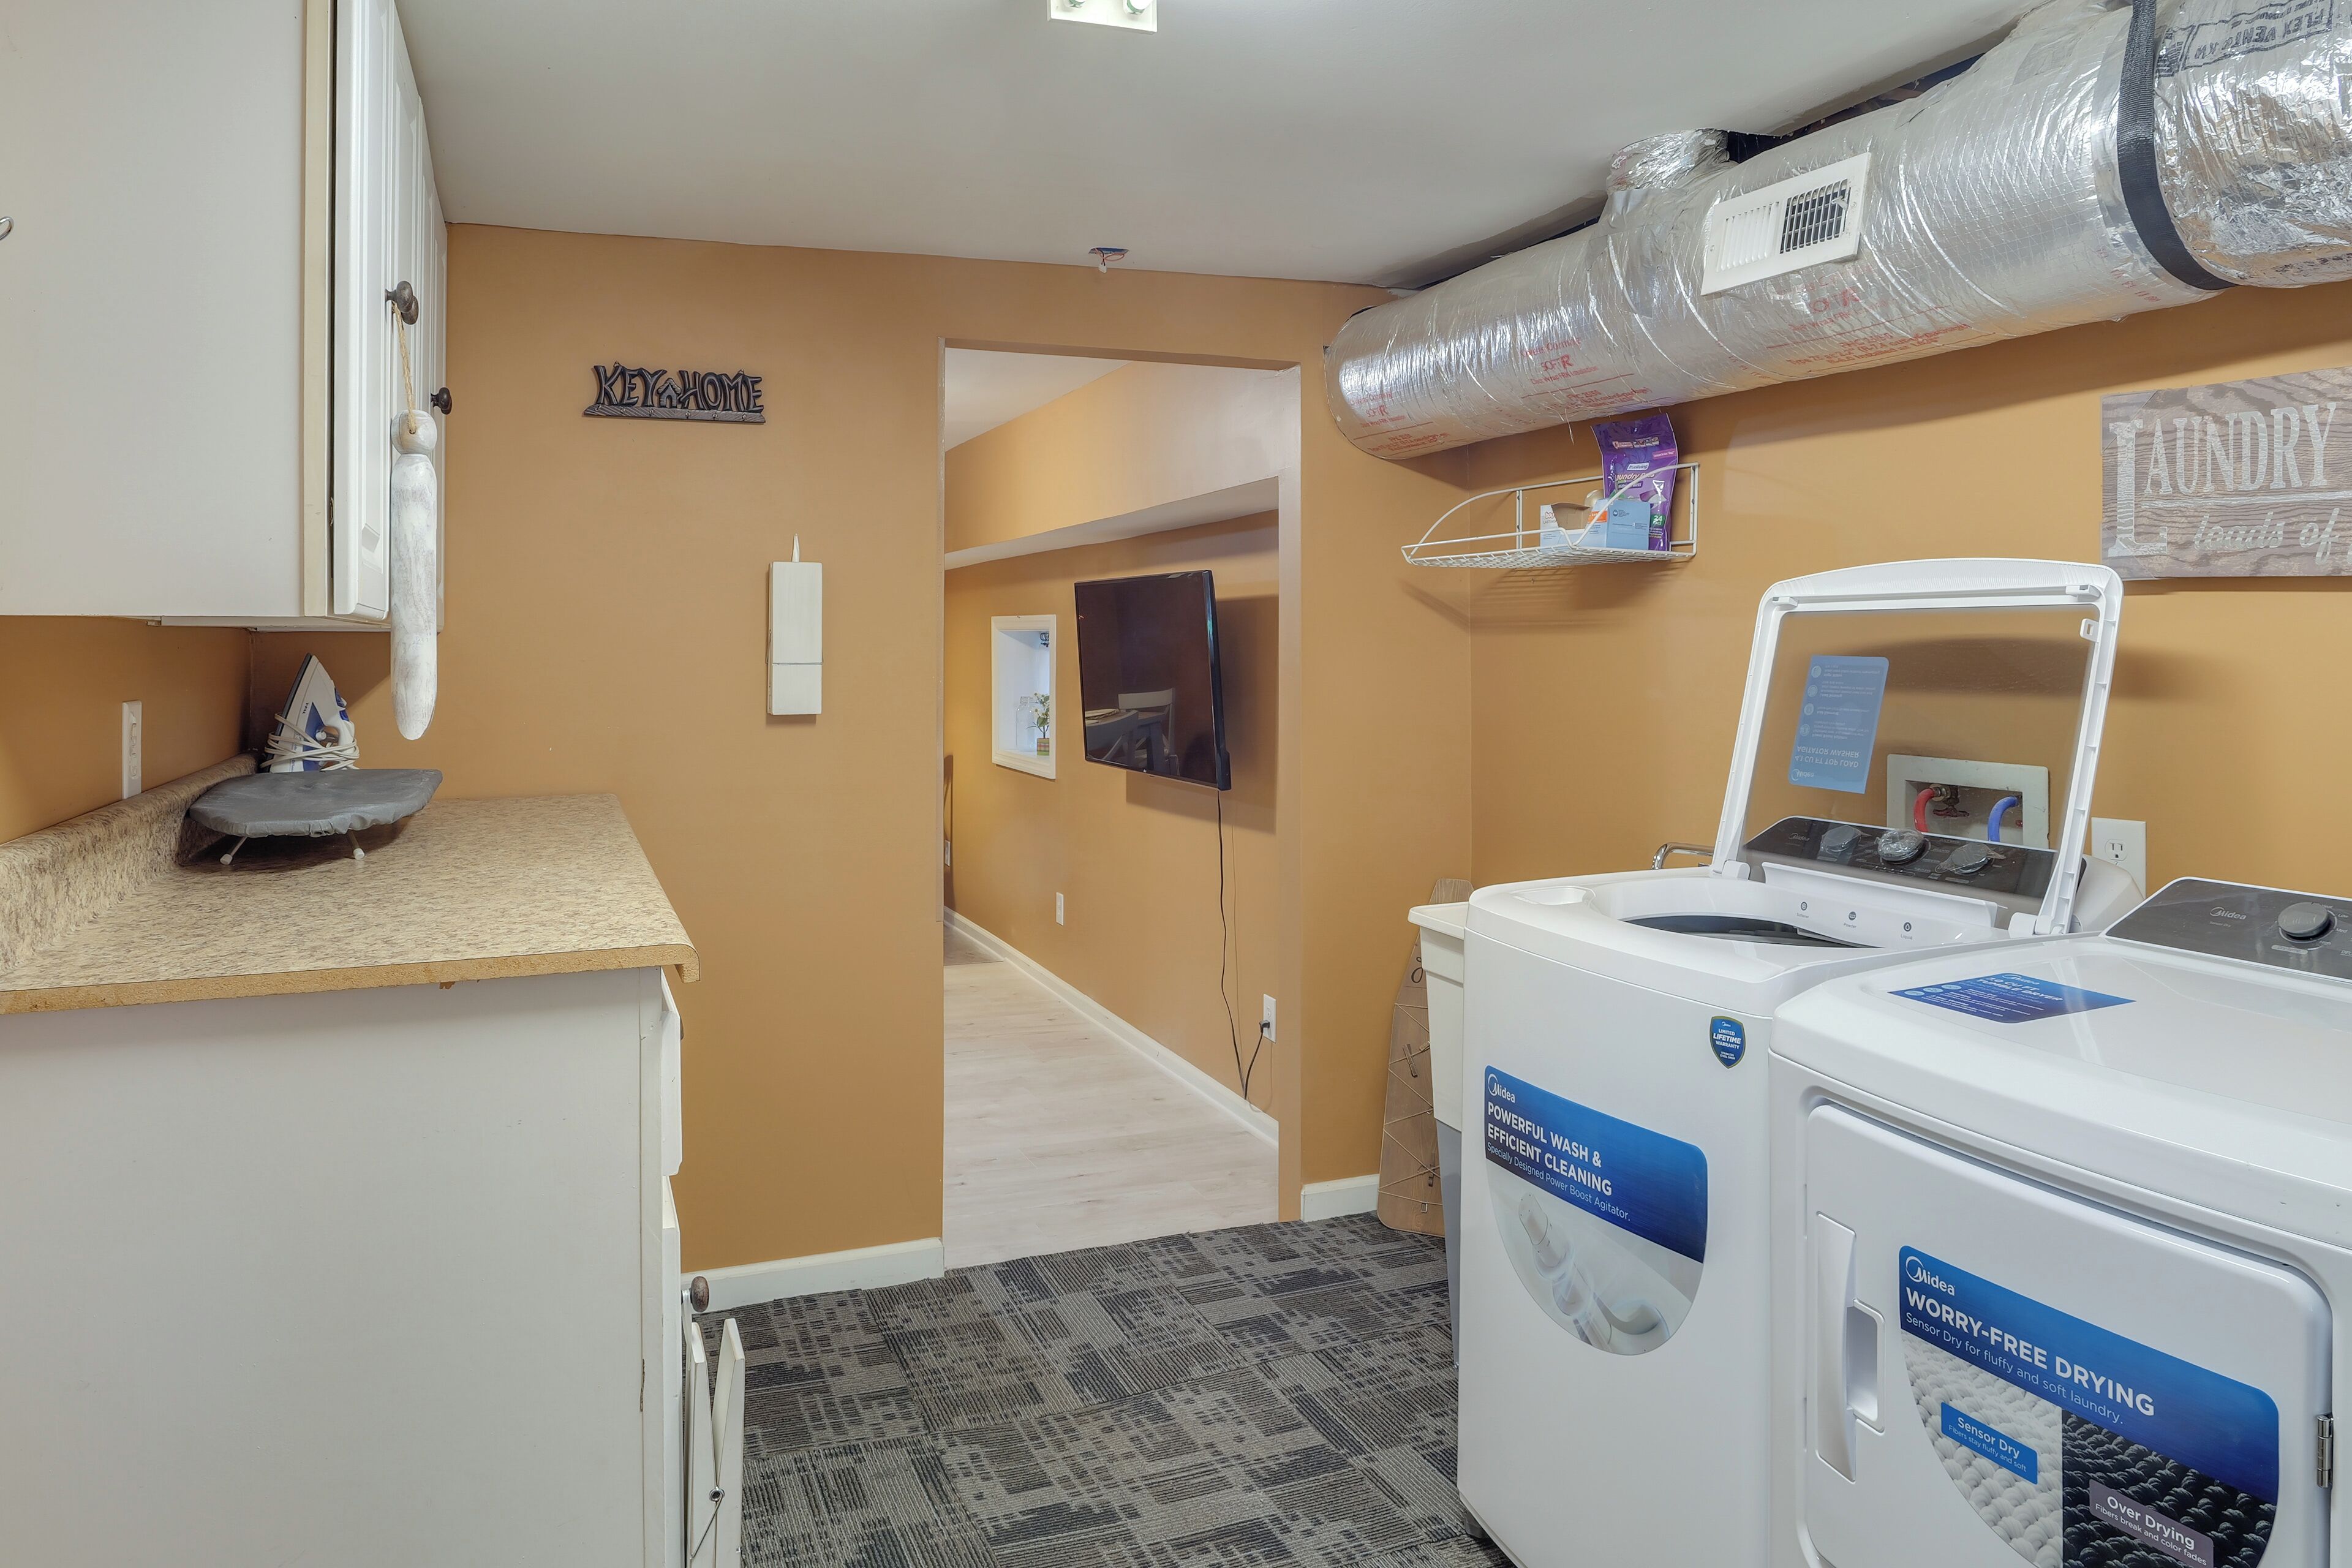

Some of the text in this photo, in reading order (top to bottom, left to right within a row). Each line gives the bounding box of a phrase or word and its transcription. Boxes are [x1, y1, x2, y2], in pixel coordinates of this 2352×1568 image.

[594, 365, 764, 413] KEY HOME
[2108, 402, 2337, 557] LAUNDRY
[2194, 511, 2285, 550] loads
[2299, 508, 2340, 565] of
[2210, 907, 2247, 920] Midea
[2021, 990, 2063, 1001] DRYER
[1713, 1033, 1741, 1044] LIFETIME
[1715, 1041, 1740, 1049] WARRANTY
[1488, 1073, 1515, 1103] Midea
[1488, 1101, 1602, 1168] POWERFUL WASH &
[1488, 1123, 1612, 1196] EFFICIENT CLEANING
[1487, 1142, 1631, 1222] Specially Designed Power Boost Agitator.
[1905, 1256, 1956, 1297] Midea
[1906, 1286, 2155, 1417] WORRY-FREE DRYING
[1906, 1312, 2124, 1426] Sensor Dry for fluffy and soft laundry.
[1948, 1424, 2027, 1472] Fibers stay fluffy and soft
[1958, 1417, 2020, 1459] Sensor Dry
[2095, 1503, 2207, 1567] Fibers break and color fades
[2107, 1496, 2195, 1551] Over Drying
